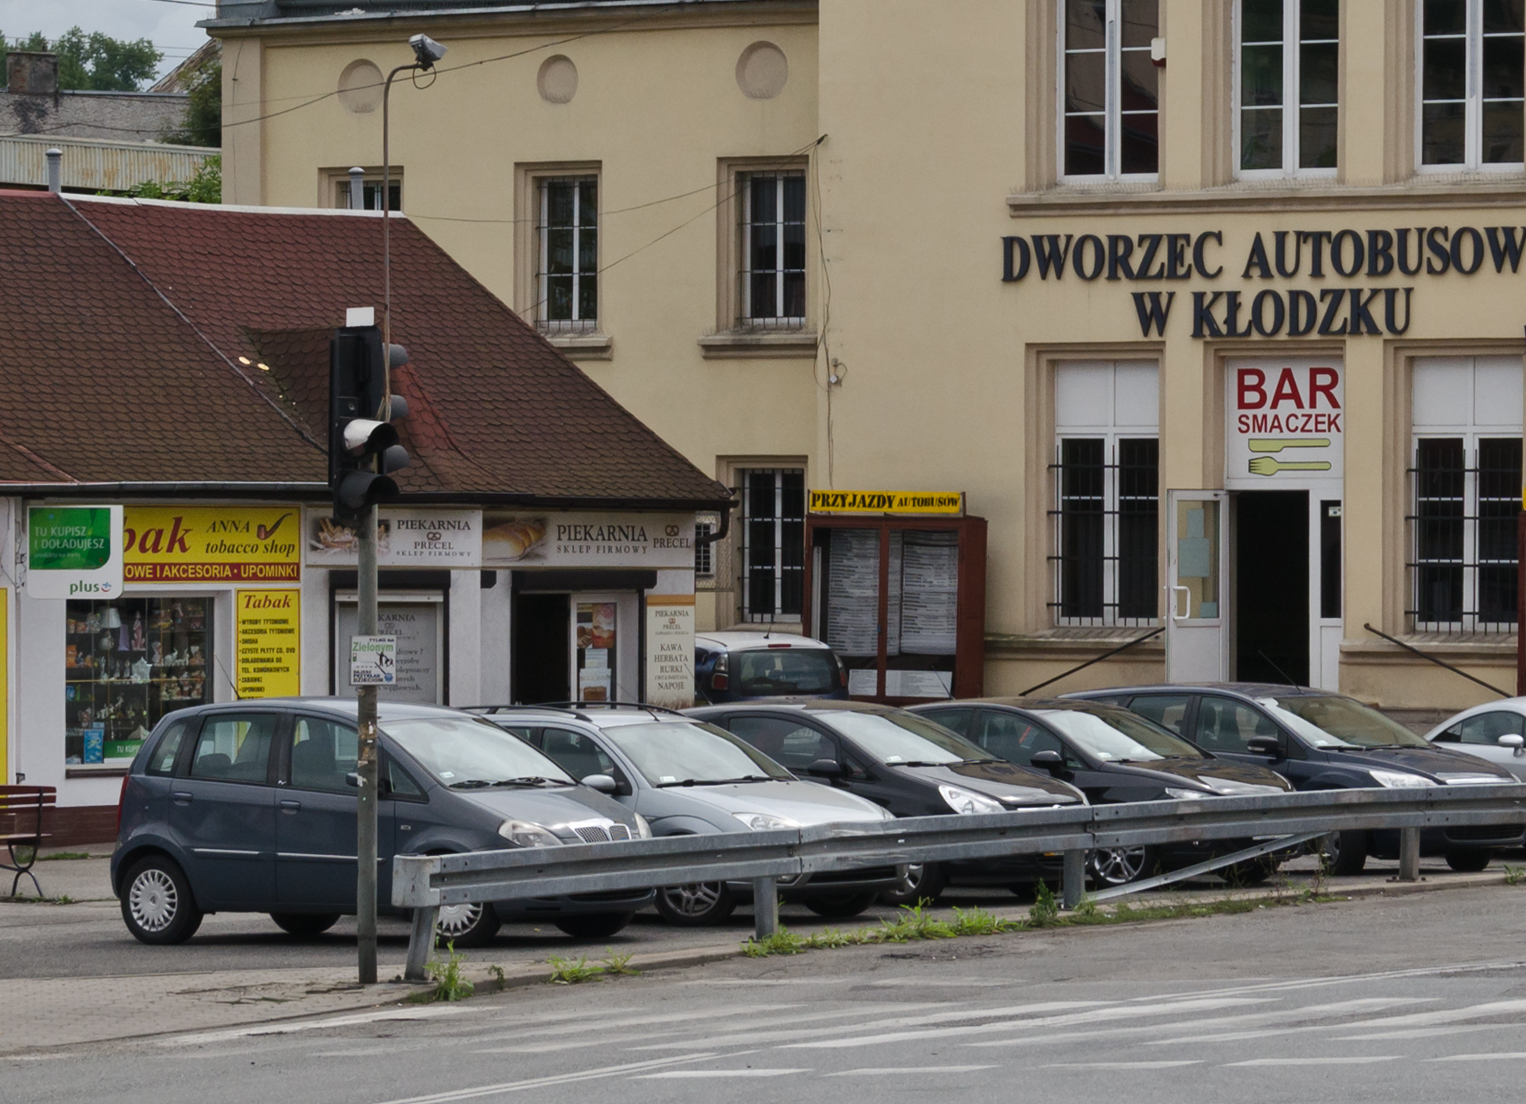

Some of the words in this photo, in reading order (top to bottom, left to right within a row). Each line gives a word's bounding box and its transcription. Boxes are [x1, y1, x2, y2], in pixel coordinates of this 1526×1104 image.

[1000, 230, 1224, 283] DWORZEC
[1130, 291, 1176, 338] W
[1190, 286, 1415, 339] KŁODZKU
[1236, 367, 1342, 410] BAR
[1237, 413, 1342, 434] SMACZEK
[811, 492, 896, 508] PRZYJAZDY
[897, 494, 960, 507] AUTOBUSÓW
[35, 526, 47, 537] TU
[50, 526, 87, 537] KUPISZ
[397, 519, 472, 531] PIEKARNIA
[124, 515, 194, 554] bak
[205, 519, 250, 533] ANNA
[556, 524, 648, 542] PIEKARNIA
[653, 537, 692, 548] PRECEL
[41, 538, 105, 551] DOŁADUJESZ
[205, 539, 259, 554] tobacco
[262, 539, 296, 557] shop
[414, 541, 455, 550] PRECEL
[557, 545, 592, 554] SKLEP
[596, 545, 648, 554] FIRMOWY
[162, 565, 232, 578] AKCESORIA
[240, 565, 298, 578] UPOMINKI
[69, 580, 100, 595] plus
[244, 594, 292, 609] Tabak
[377, 613, 416, 622] KARNIA
[352, 642, 394, 653] Zielonym
[654, 654, 689, 663] HERBATA
[660, 665, 683, 673] RURKI
[658, 682, 685, 691] NAPOJE
